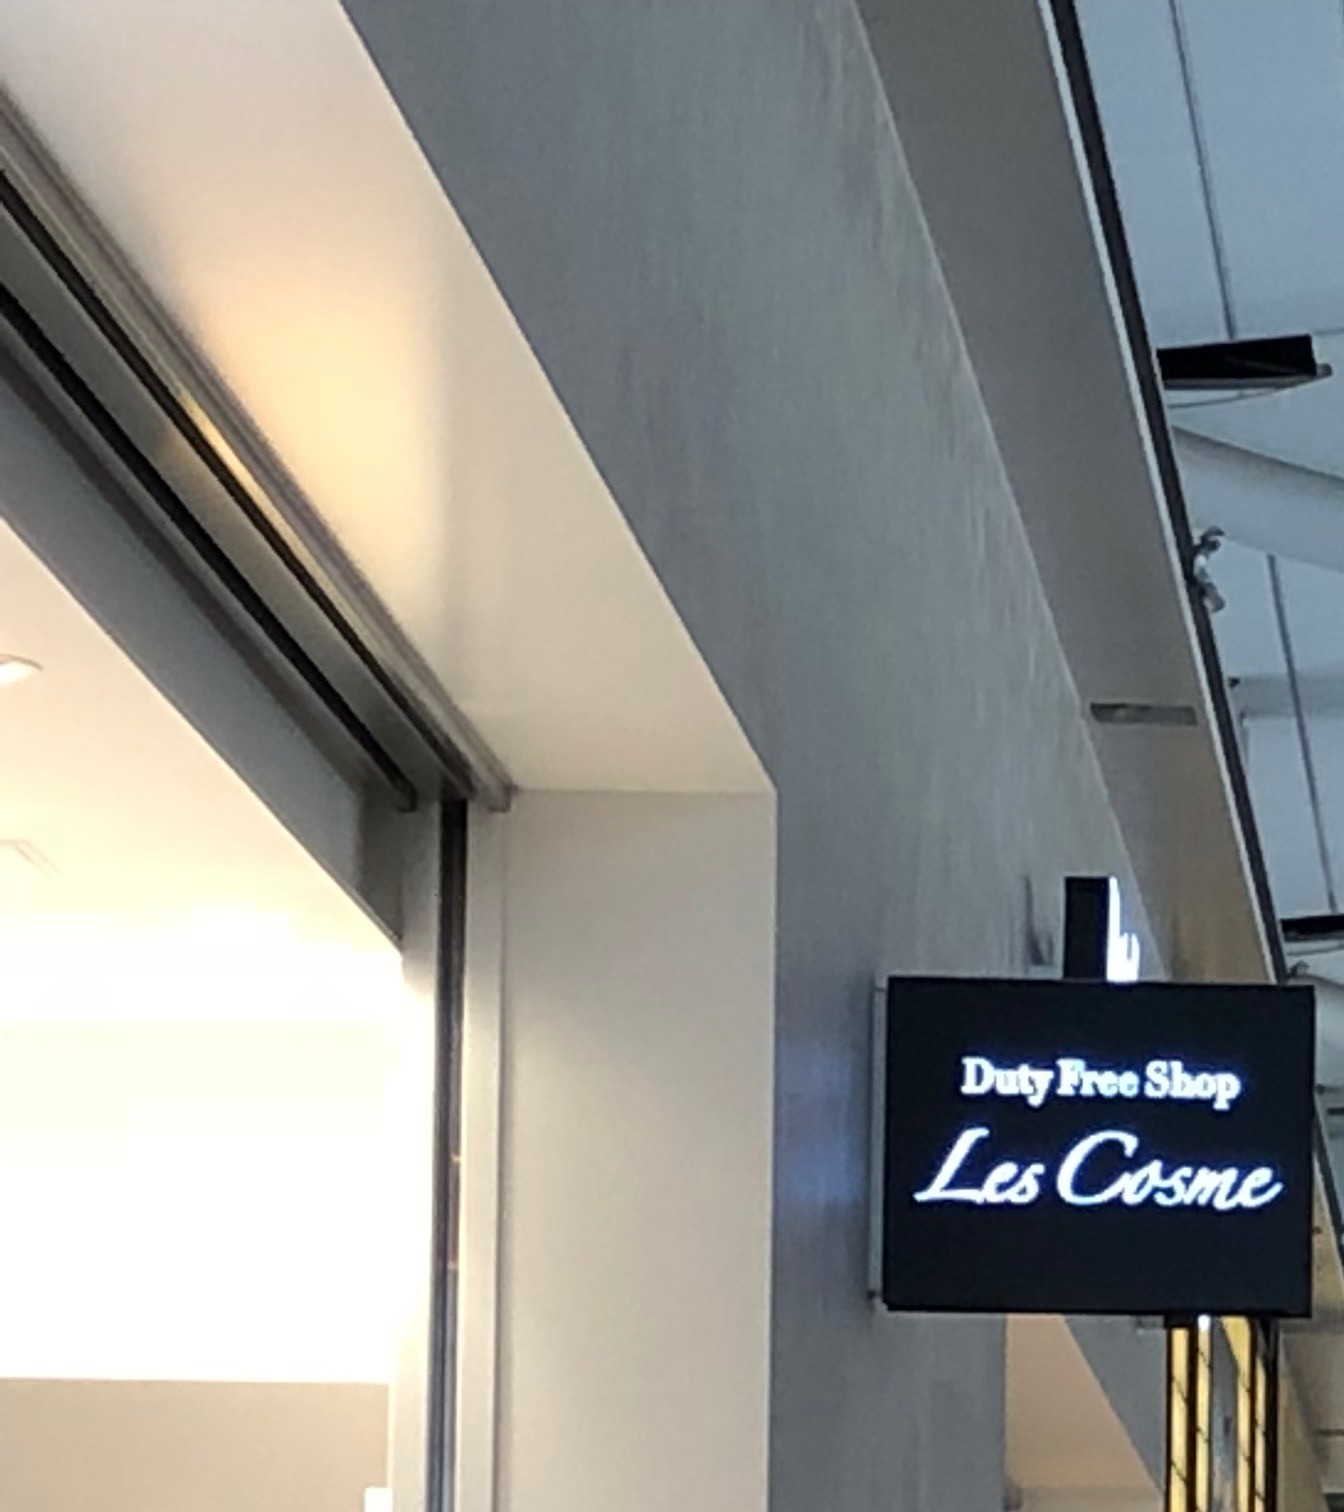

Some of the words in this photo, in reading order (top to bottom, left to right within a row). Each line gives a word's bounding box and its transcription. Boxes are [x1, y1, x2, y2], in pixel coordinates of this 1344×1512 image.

[960, 1056, 1054, 1108] Duty
[1056, 1057, 1140, 1098] Free
[1143, 1060, 1242, 1110] Shop
[912, 1126, 1046, 1204] Les
[1055, 1129, 1284, 1210] Cosme
